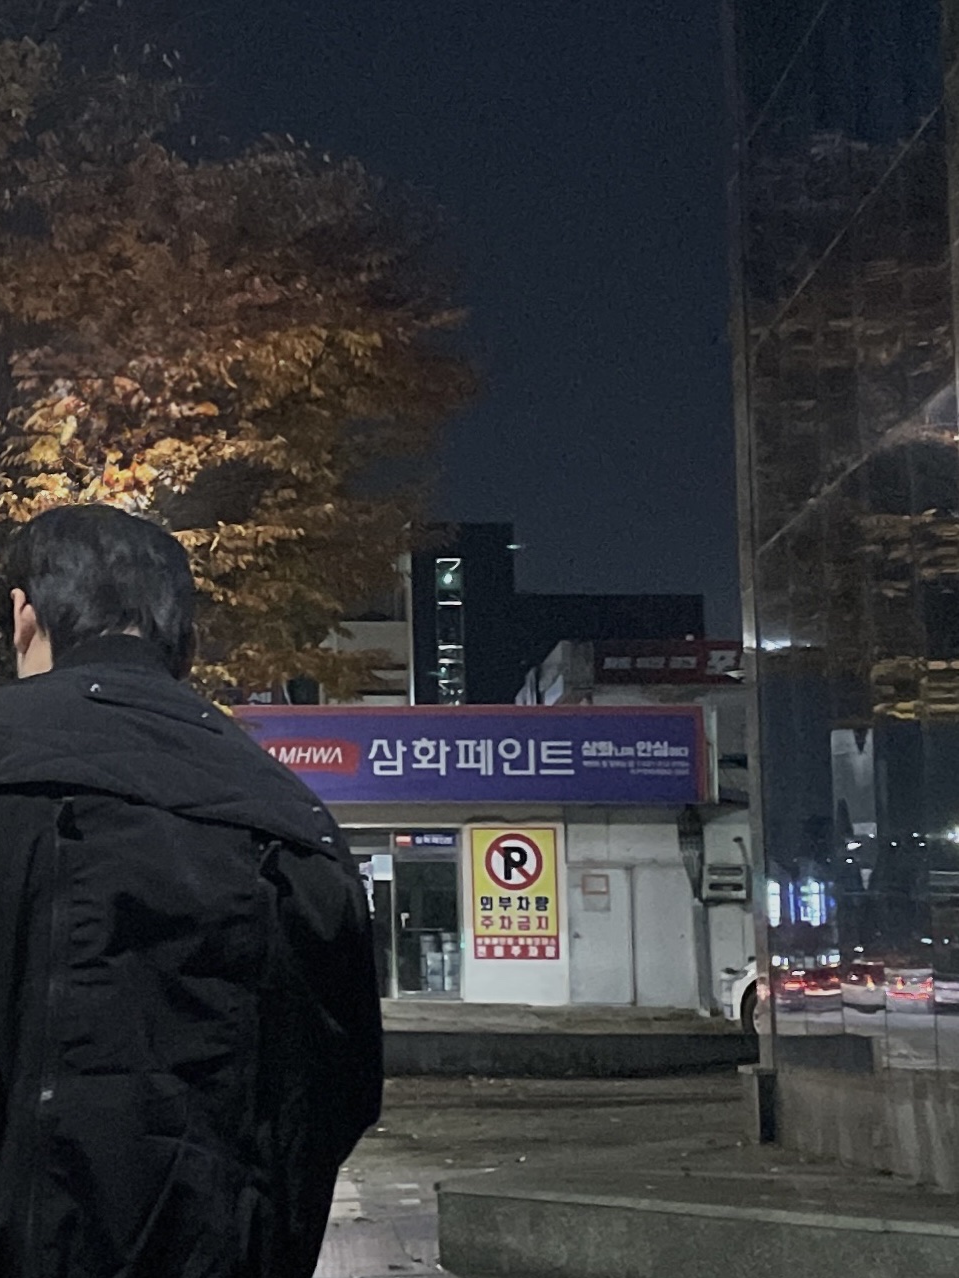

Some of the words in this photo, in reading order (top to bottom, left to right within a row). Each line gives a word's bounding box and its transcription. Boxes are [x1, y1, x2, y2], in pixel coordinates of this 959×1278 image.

[368, 737, 575, 776] 삼화페인트
[480, 895, 549, 912] 외부차량
[481, 914, 550, 931] 주차금지
